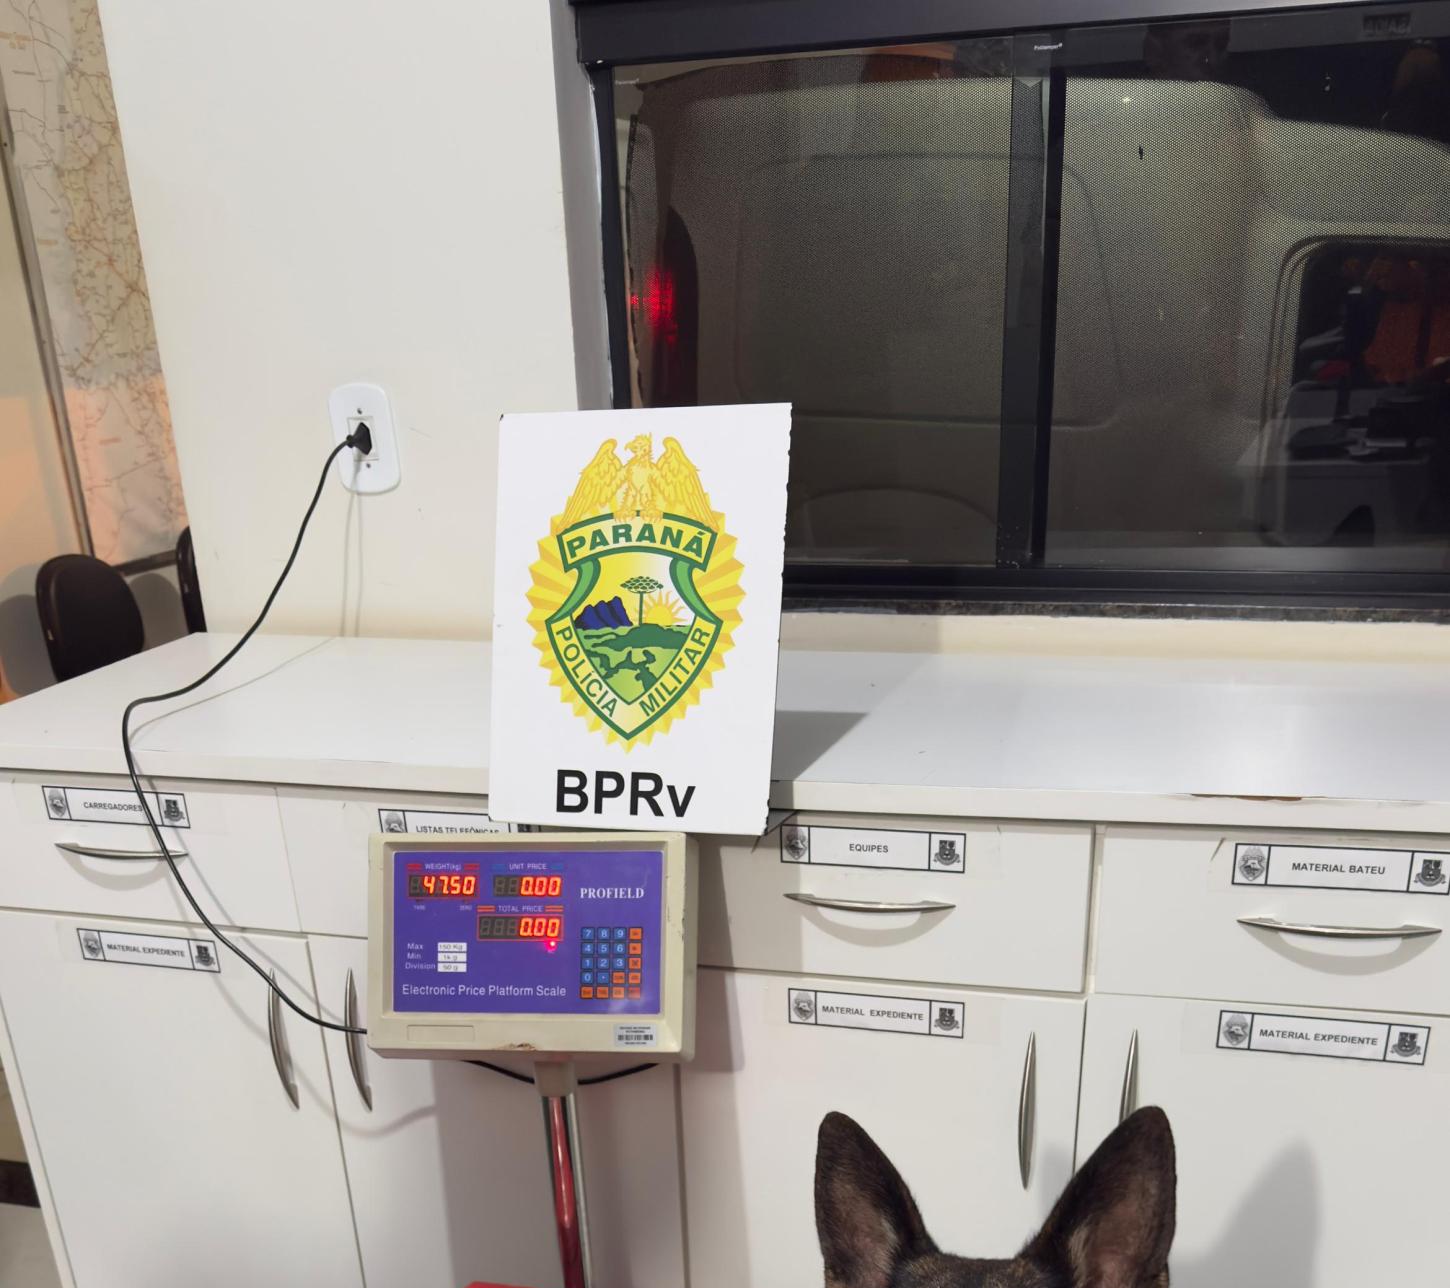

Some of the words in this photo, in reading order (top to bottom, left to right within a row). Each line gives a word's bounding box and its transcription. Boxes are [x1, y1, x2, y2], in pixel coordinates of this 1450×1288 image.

[565, 522, 704, 559] PARANÁ
[555, 626, 618, 718] POLÍCIA
[638, 627, 710, 717] MILITAR
[556, 769, 696, 818] BPRv
[83, 801, 143, 812] CARREGADORES
[849, 843, 889, 853] EQUIPES
[1291, 863, 1346, 873] MATERIAL
[1349, 865, 1386, 875] BATEU
[580, 887, 645, 899] PROFIELD
[583, 929, 592, 937] 7
[617, 929, 624, 938] 9
[107, 943, 141, 953] MATERIAL
[142, 947, 185, 957] EXPEDIENTE
[584, 944, 591, 952] 4
[601, 944, 608, 953] 5
[616, 944, 624, 953] 6
[407, 952, 421, 960] Min
[405, 962, 436, 970] Division
[600, 959, 607, 967] 2
[616, 959, 624, 967] 3
[402, 984, 456, 996] Electronic
[458, 985, 486, 996] Price
[488, 985, 533, 996] Platform
[536, 985, 567, 996] Scale
[822, 1005, 865, 1016] MATERIAL
[870, 1009, 924, 1021] EXPEDIENTE
[1259, 1028, 1311, 1041] MATERIAL
[1313, 1033, 1378, 1046] EXPEDIENTE
